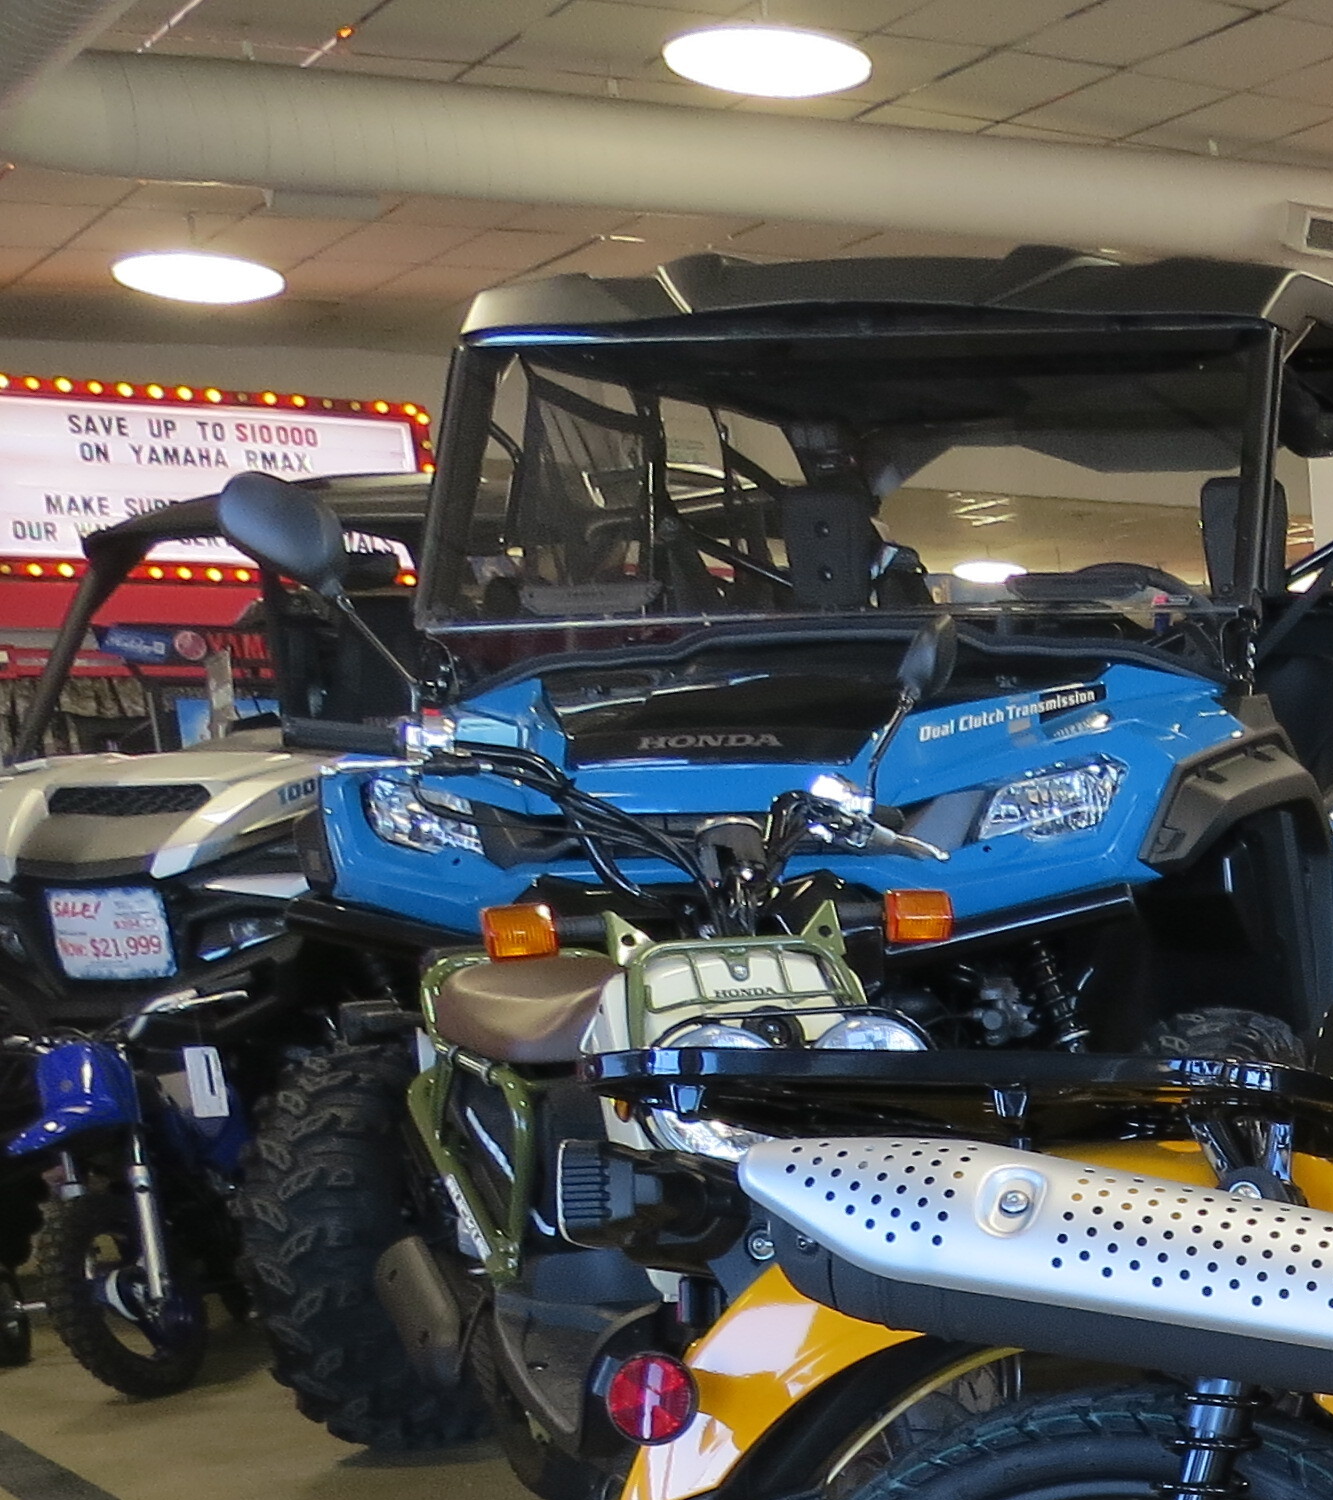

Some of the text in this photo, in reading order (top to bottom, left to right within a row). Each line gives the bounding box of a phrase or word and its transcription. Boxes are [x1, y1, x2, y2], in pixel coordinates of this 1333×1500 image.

[68, 414, 129, 437] SAVE
[147, 419, 177, 439] UP
[197, 421, 226, 442] TO
[79, 441, 313, 474] ON YAMAHA RMAX
[44, 494, 182, 517] MAKE SUR
[12, 520, 58, 542] OUR
[918, 687, 1096, 743] Dual Clutch Transmission
[637, 733, 784, 750] HONDA
[54, 901, 102, 920] SALE!
[90, 934, 162, 960] $21,999
[714, 986, 777, 998] HONDA
